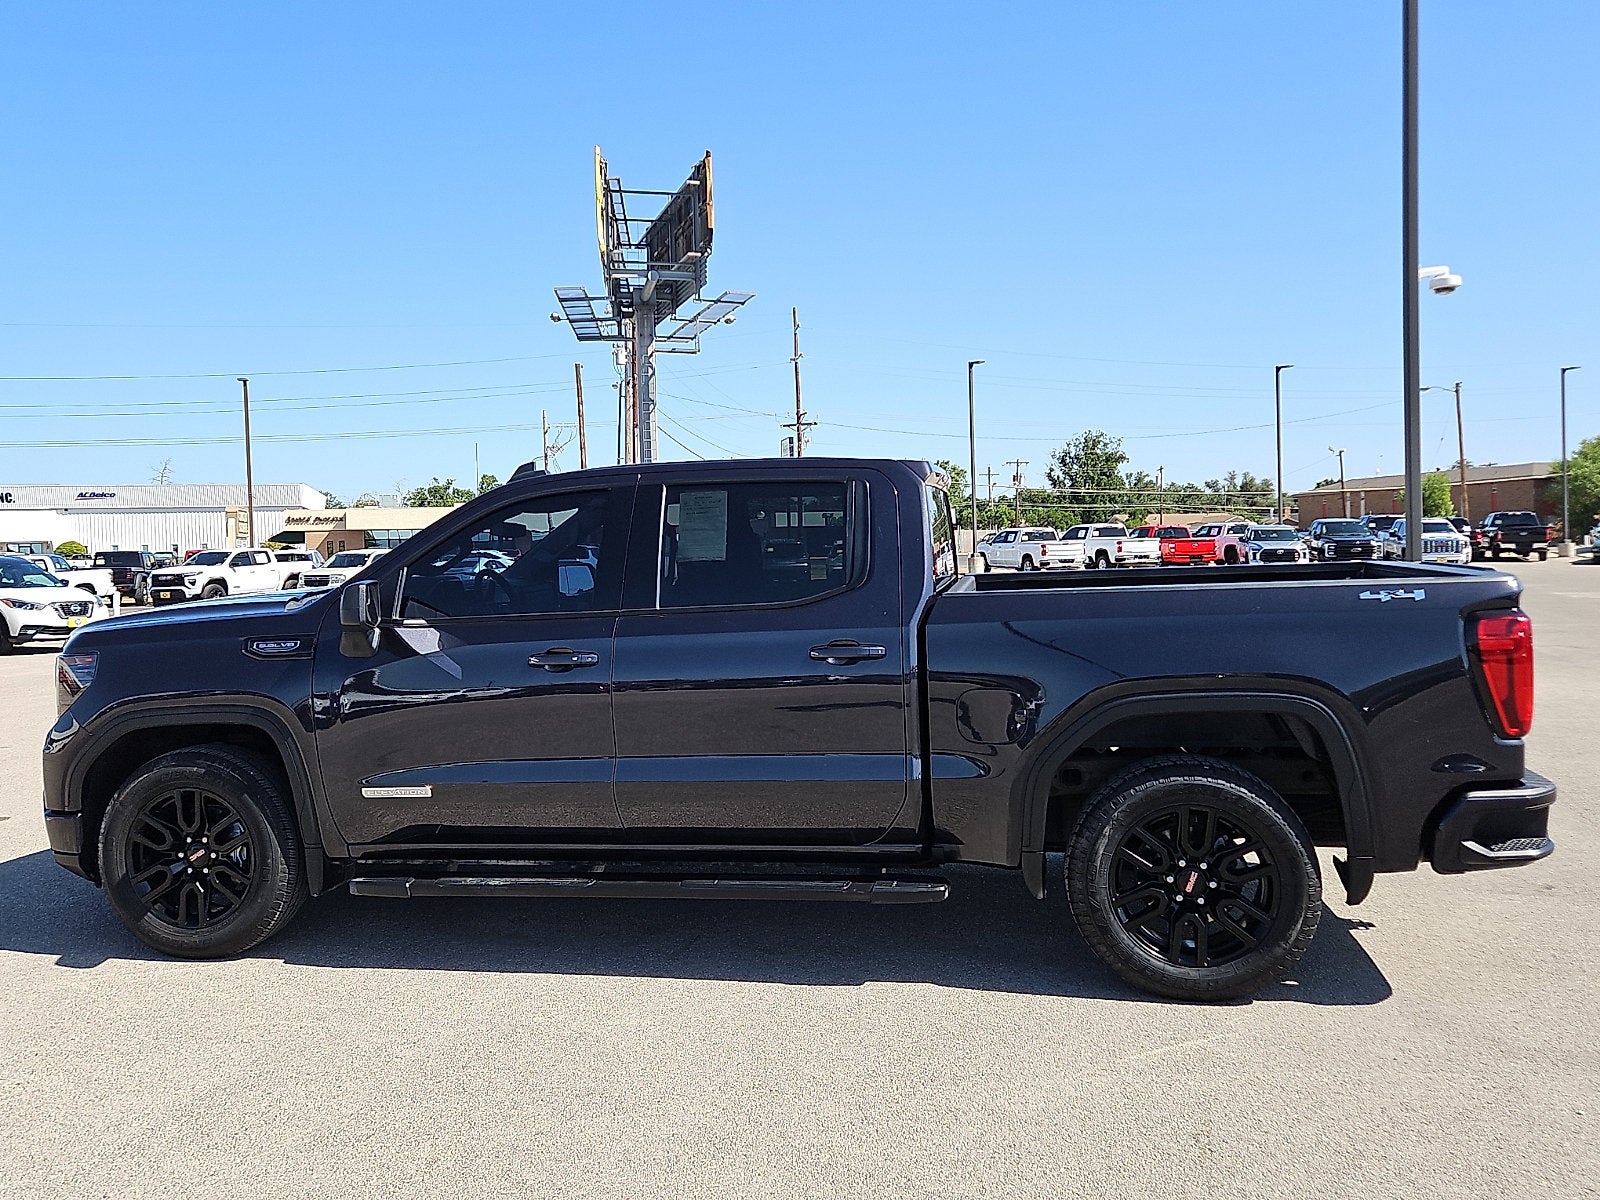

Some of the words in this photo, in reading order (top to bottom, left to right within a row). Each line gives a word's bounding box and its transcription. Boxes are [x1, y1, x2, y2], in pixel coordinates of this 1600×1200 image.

[364, 788, 430, 797] ELEVATION
[188, 849, 206, 862] GMC
[1185, 871, 1199, 893] GMC
